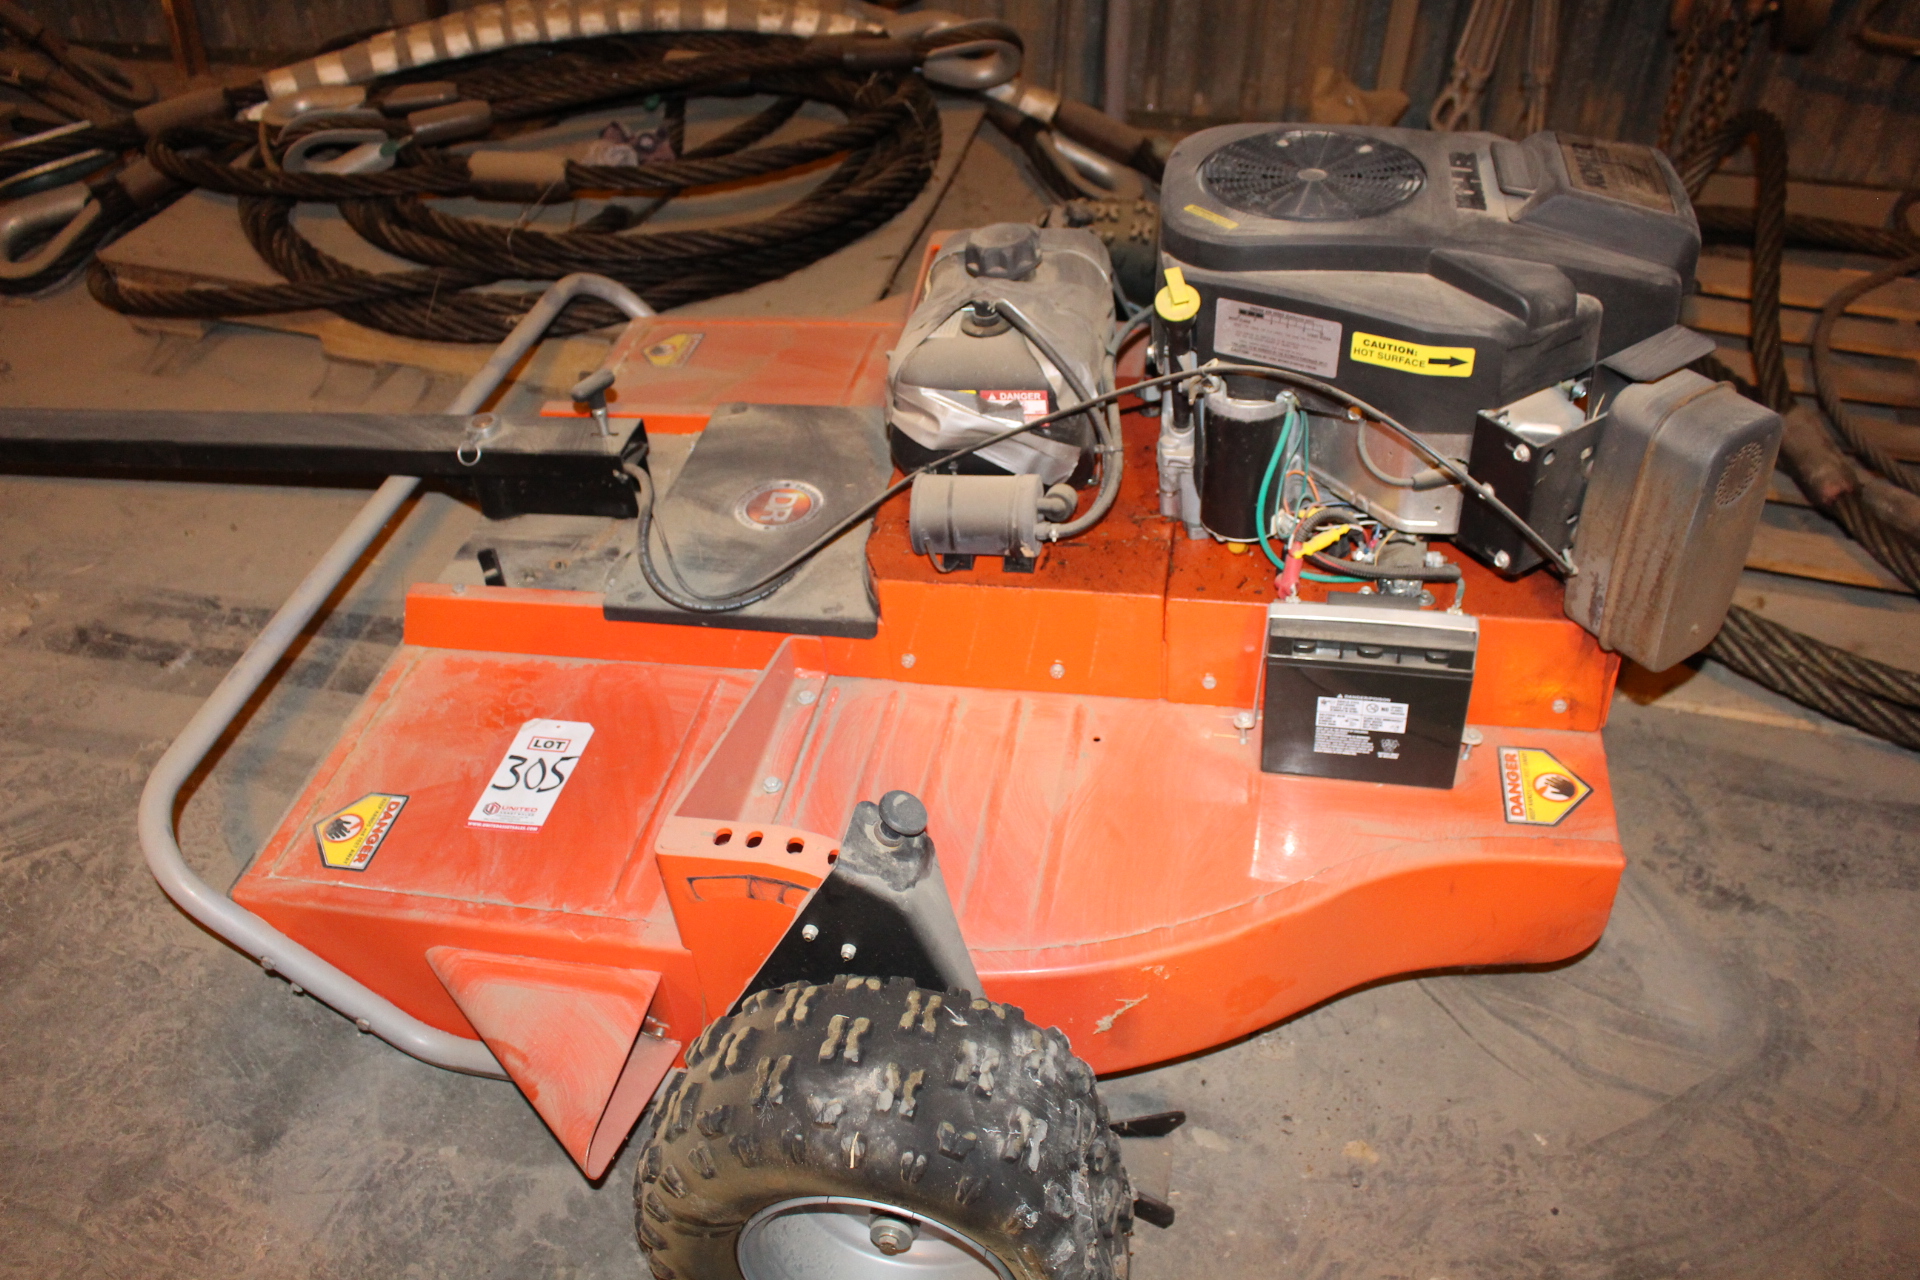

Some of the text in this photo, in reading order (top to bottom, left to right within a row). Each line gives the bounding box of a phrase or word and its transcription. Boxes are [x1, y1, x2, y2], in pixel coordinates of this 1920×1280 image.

[1353, 347, 1426, 368] HOT SURFACE
[1363, 338, 1418, 356] CAUTION:
[1000, 392, 1041, 400] DANGER
[533, 739, 566, 750] LOT
[491, 754, 580, 793] 305
[1504, 753, 1524, 817] DANGER
[353, 801, 401, 863] DANGER
